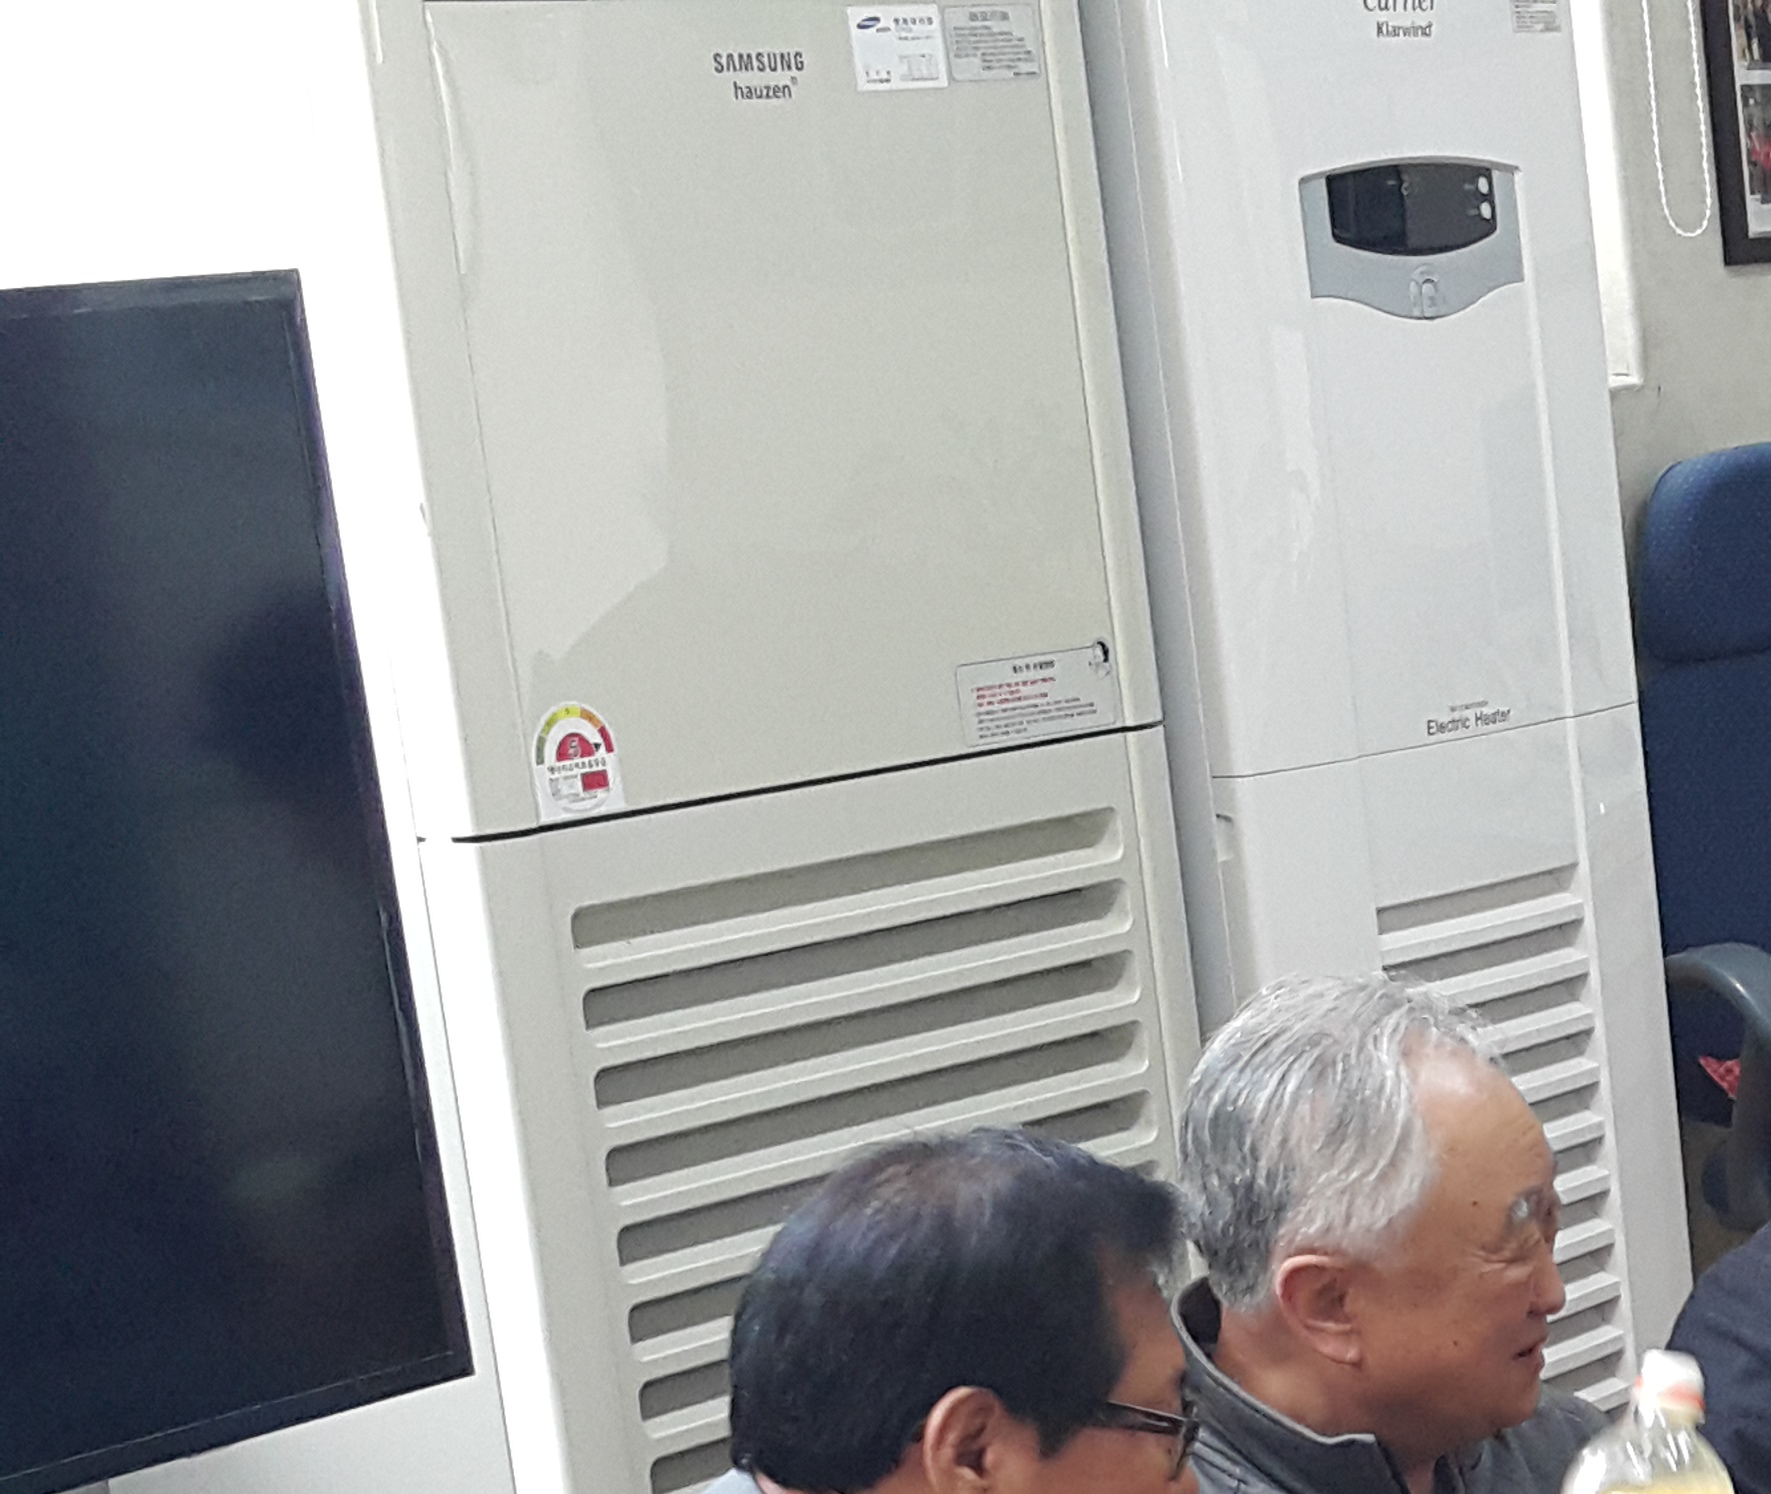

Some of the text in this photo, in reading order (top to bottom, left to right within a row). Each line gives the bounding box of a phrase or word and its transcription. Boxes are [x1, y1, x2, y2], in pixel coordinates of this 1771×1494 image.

[713, 52, 804, 74] SAMSUNG
[733, 80, 792, 101] hauzen
[1427, 717, 1471, 736] Electric
